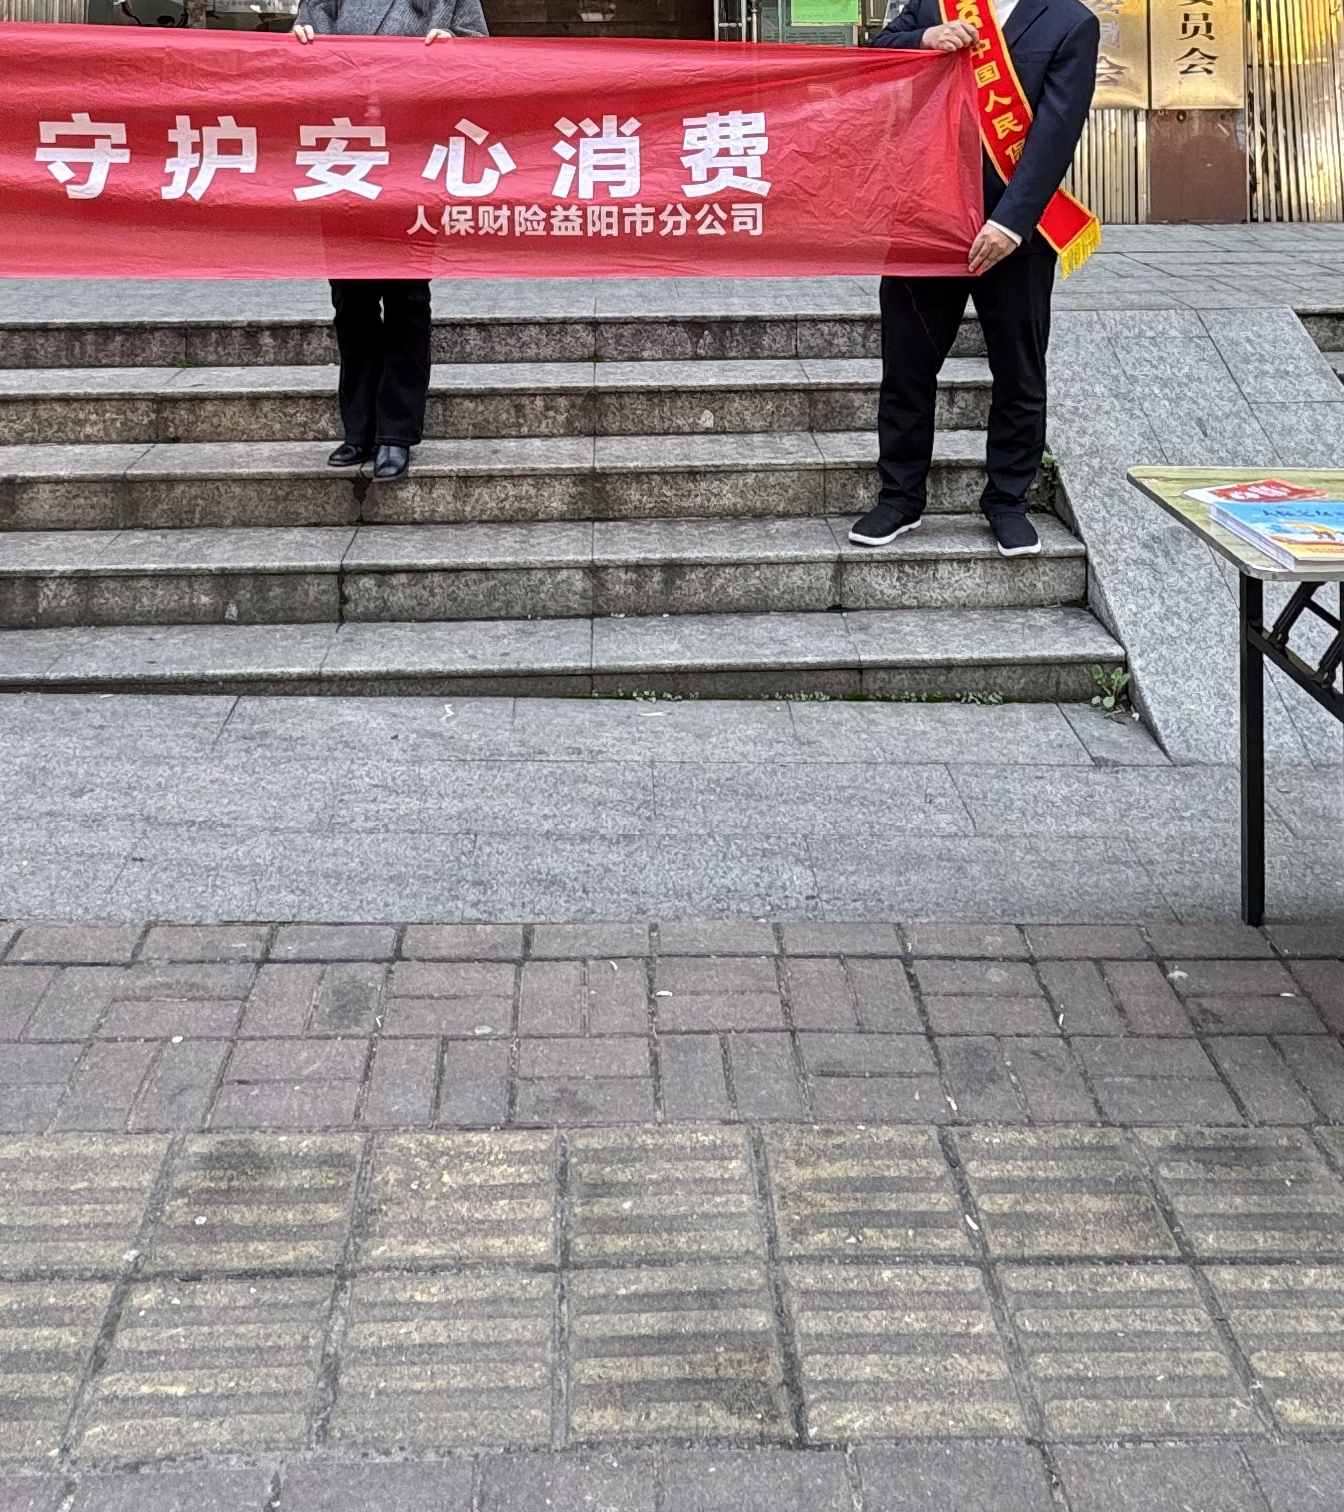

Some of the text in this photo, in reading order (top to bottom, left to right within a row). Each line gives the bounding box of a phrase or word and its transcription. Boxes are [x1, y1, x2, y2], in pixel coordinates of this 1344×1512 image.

[32, 109, 772, 203] 守护安心消费
[404, 201, 765, 239] 人保财险益阳市分公司
